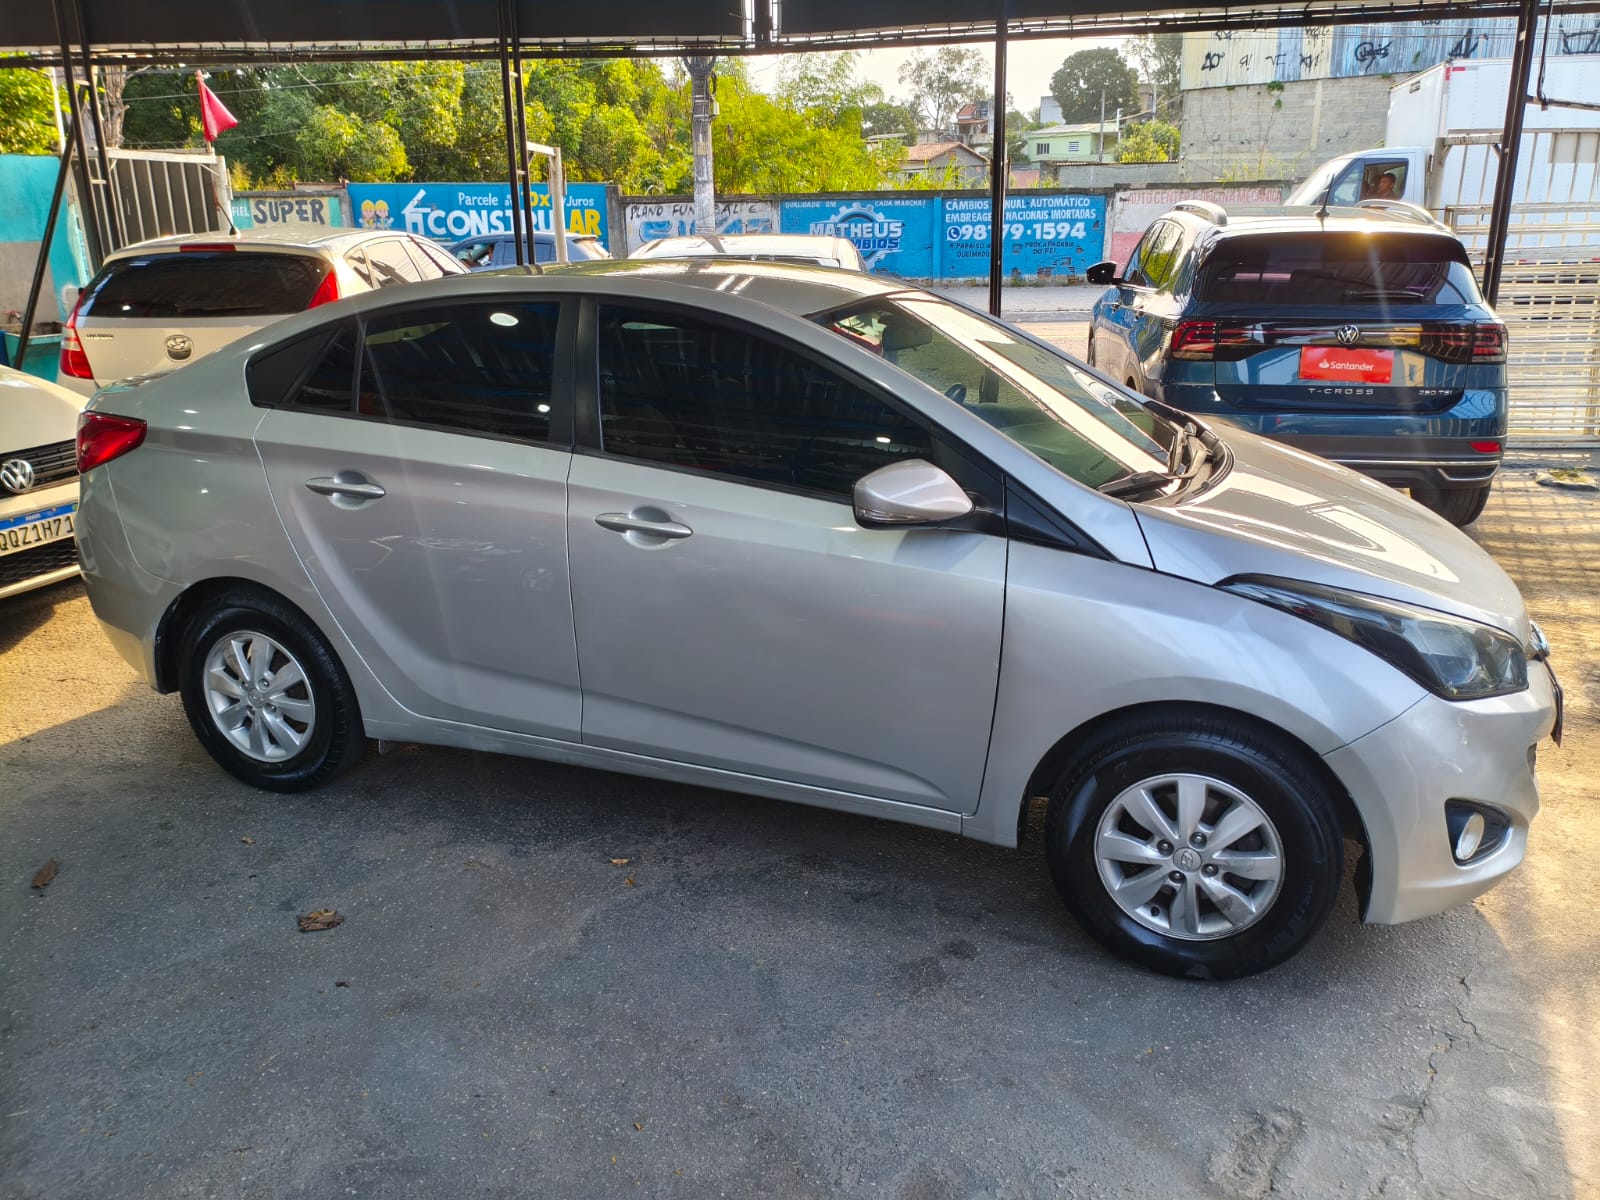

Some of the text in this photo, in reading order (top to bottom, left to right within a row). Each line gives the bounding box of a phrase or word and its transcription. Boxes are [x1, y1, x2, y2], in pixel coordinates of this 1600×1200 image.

[458, 192, 498, 206] Parcele
[785, 201, 821, 209] QUALIDADE
[894, 199, 926, 209] MARCHA!
[1030, 195, 1090, 208] AUTOMÁTICO
[1129, 192, 1152, 205] AUTO
[1154, 190, 1189, 204] CENTER
[253, 198, 325, 224] SUPER
[630, 204, 663, 220] PLANO
[1006, 210, 1049, 221] NACIONAIS
[1051, 208, 1096, 220] IMORTADAS
[809, 222, 904, 238] MATHEUS
[1330, 361, 1375, 372] Santander
[1308, 387, 1374, 396] T-CROSS
